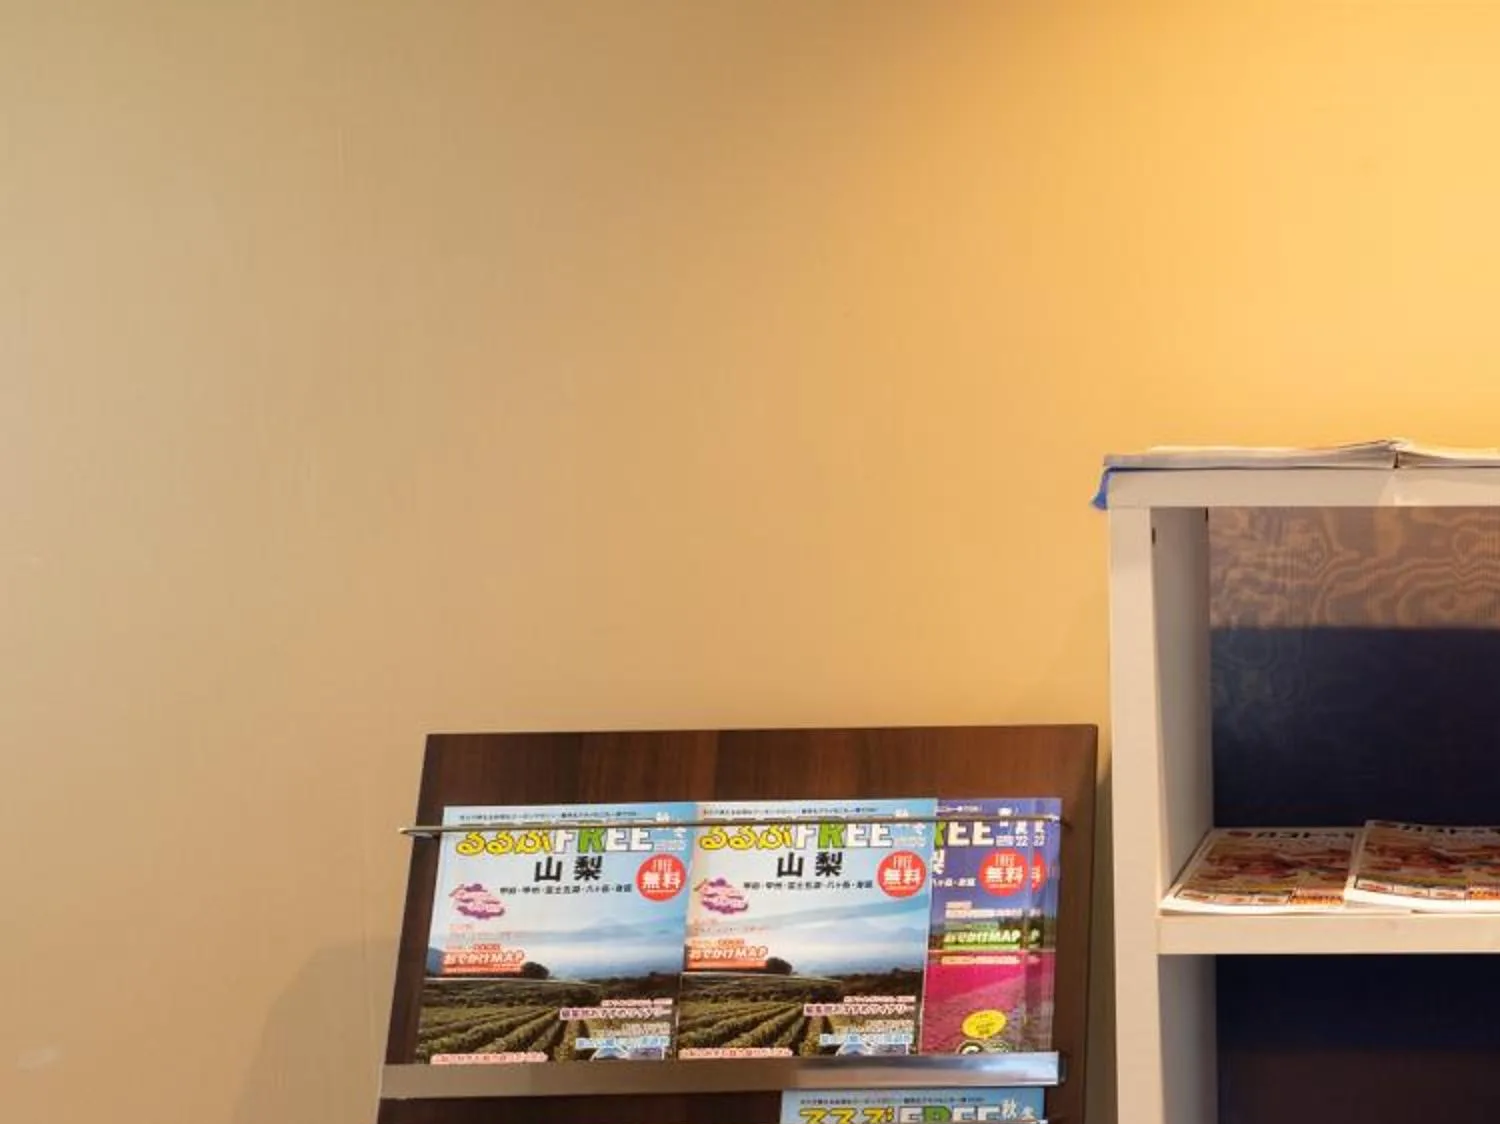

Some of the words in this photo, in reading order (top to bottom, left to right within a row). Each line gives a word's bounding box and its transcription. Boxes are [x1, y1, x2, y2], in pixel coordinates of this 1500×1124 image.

[534, 856, 602, 882] 山梨
[777, 851, 843, 878] 山梨
[642, 871, 681, 889] 無料
[883, 867, 921, 884] 無料
[985, 866, 1024, 883] 無料
